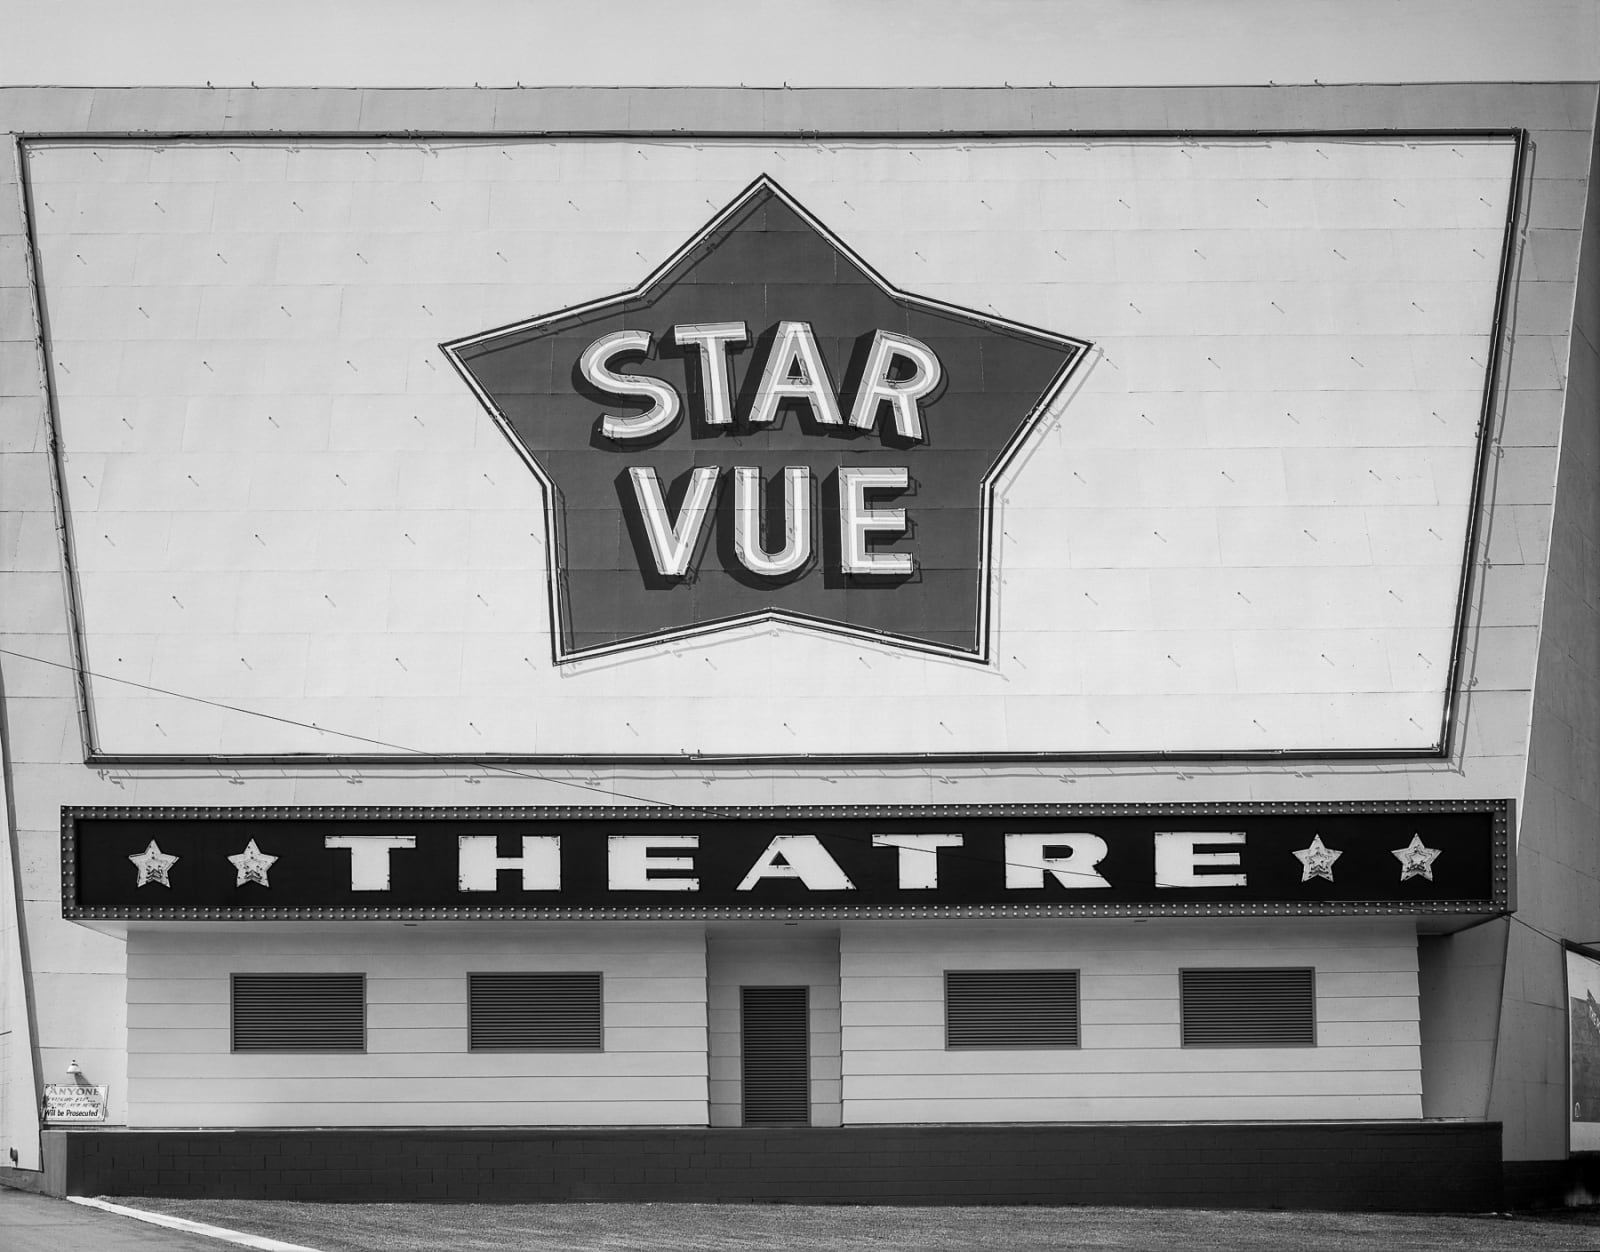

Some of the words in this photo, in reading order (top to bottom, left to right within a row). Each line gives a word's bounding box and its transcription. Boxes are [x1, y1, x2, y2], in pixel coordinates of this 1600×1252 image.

[579, 320, 942, 440] STAR
[627, 465, 914, 576] VUE
[324, 831, 1248, 892] THEATRE
[48, 1087, 100, 1096] ANYONE
[57, 1109, 65, 1117] be
[66, 1109, 99, 1117] Prosecuted
